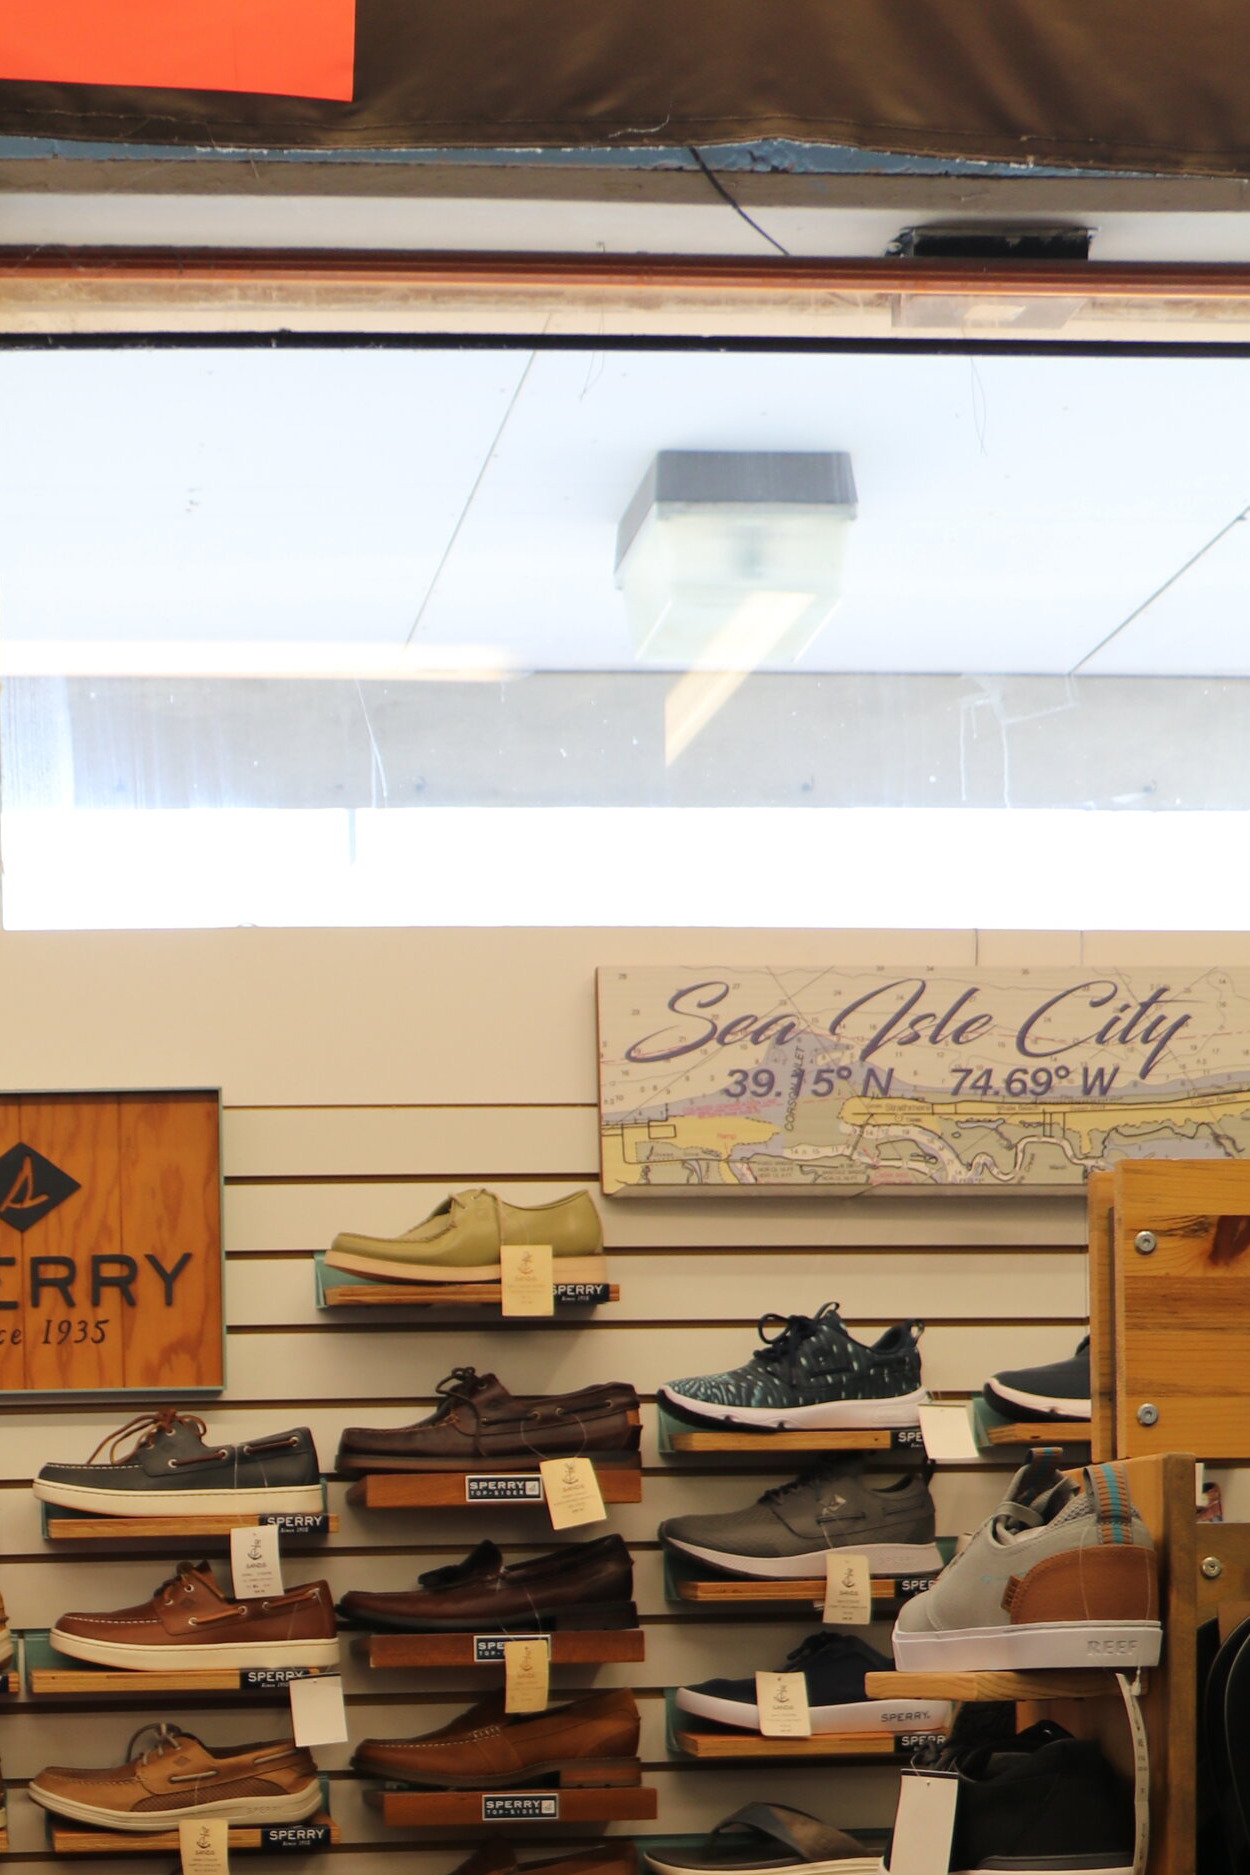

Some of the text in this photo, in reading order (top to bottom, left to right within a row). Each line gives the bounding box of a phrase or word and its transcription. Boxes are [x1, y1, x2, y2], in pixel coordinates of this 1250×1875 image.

[625, 977, 1207, 1080] Sea Isle City
[862, 1067, 895, 1097] N
[1082, 1066, 1120, 1096] W
[552, 1285, 603, 1296] SPERRY
[41, 1318, 110, 1346] 1935
[469, 1480, 525, 1490] SPERRY
[266, 1515, 322, 1527] SPERRY
[1087, 1639, 1139, 1656] REEF
[880, 1711, 931, 1722] SPERRY
[485, 1799, 541, 1809] SPERRY
[268, 1829, 325, 1841] SPERRY
